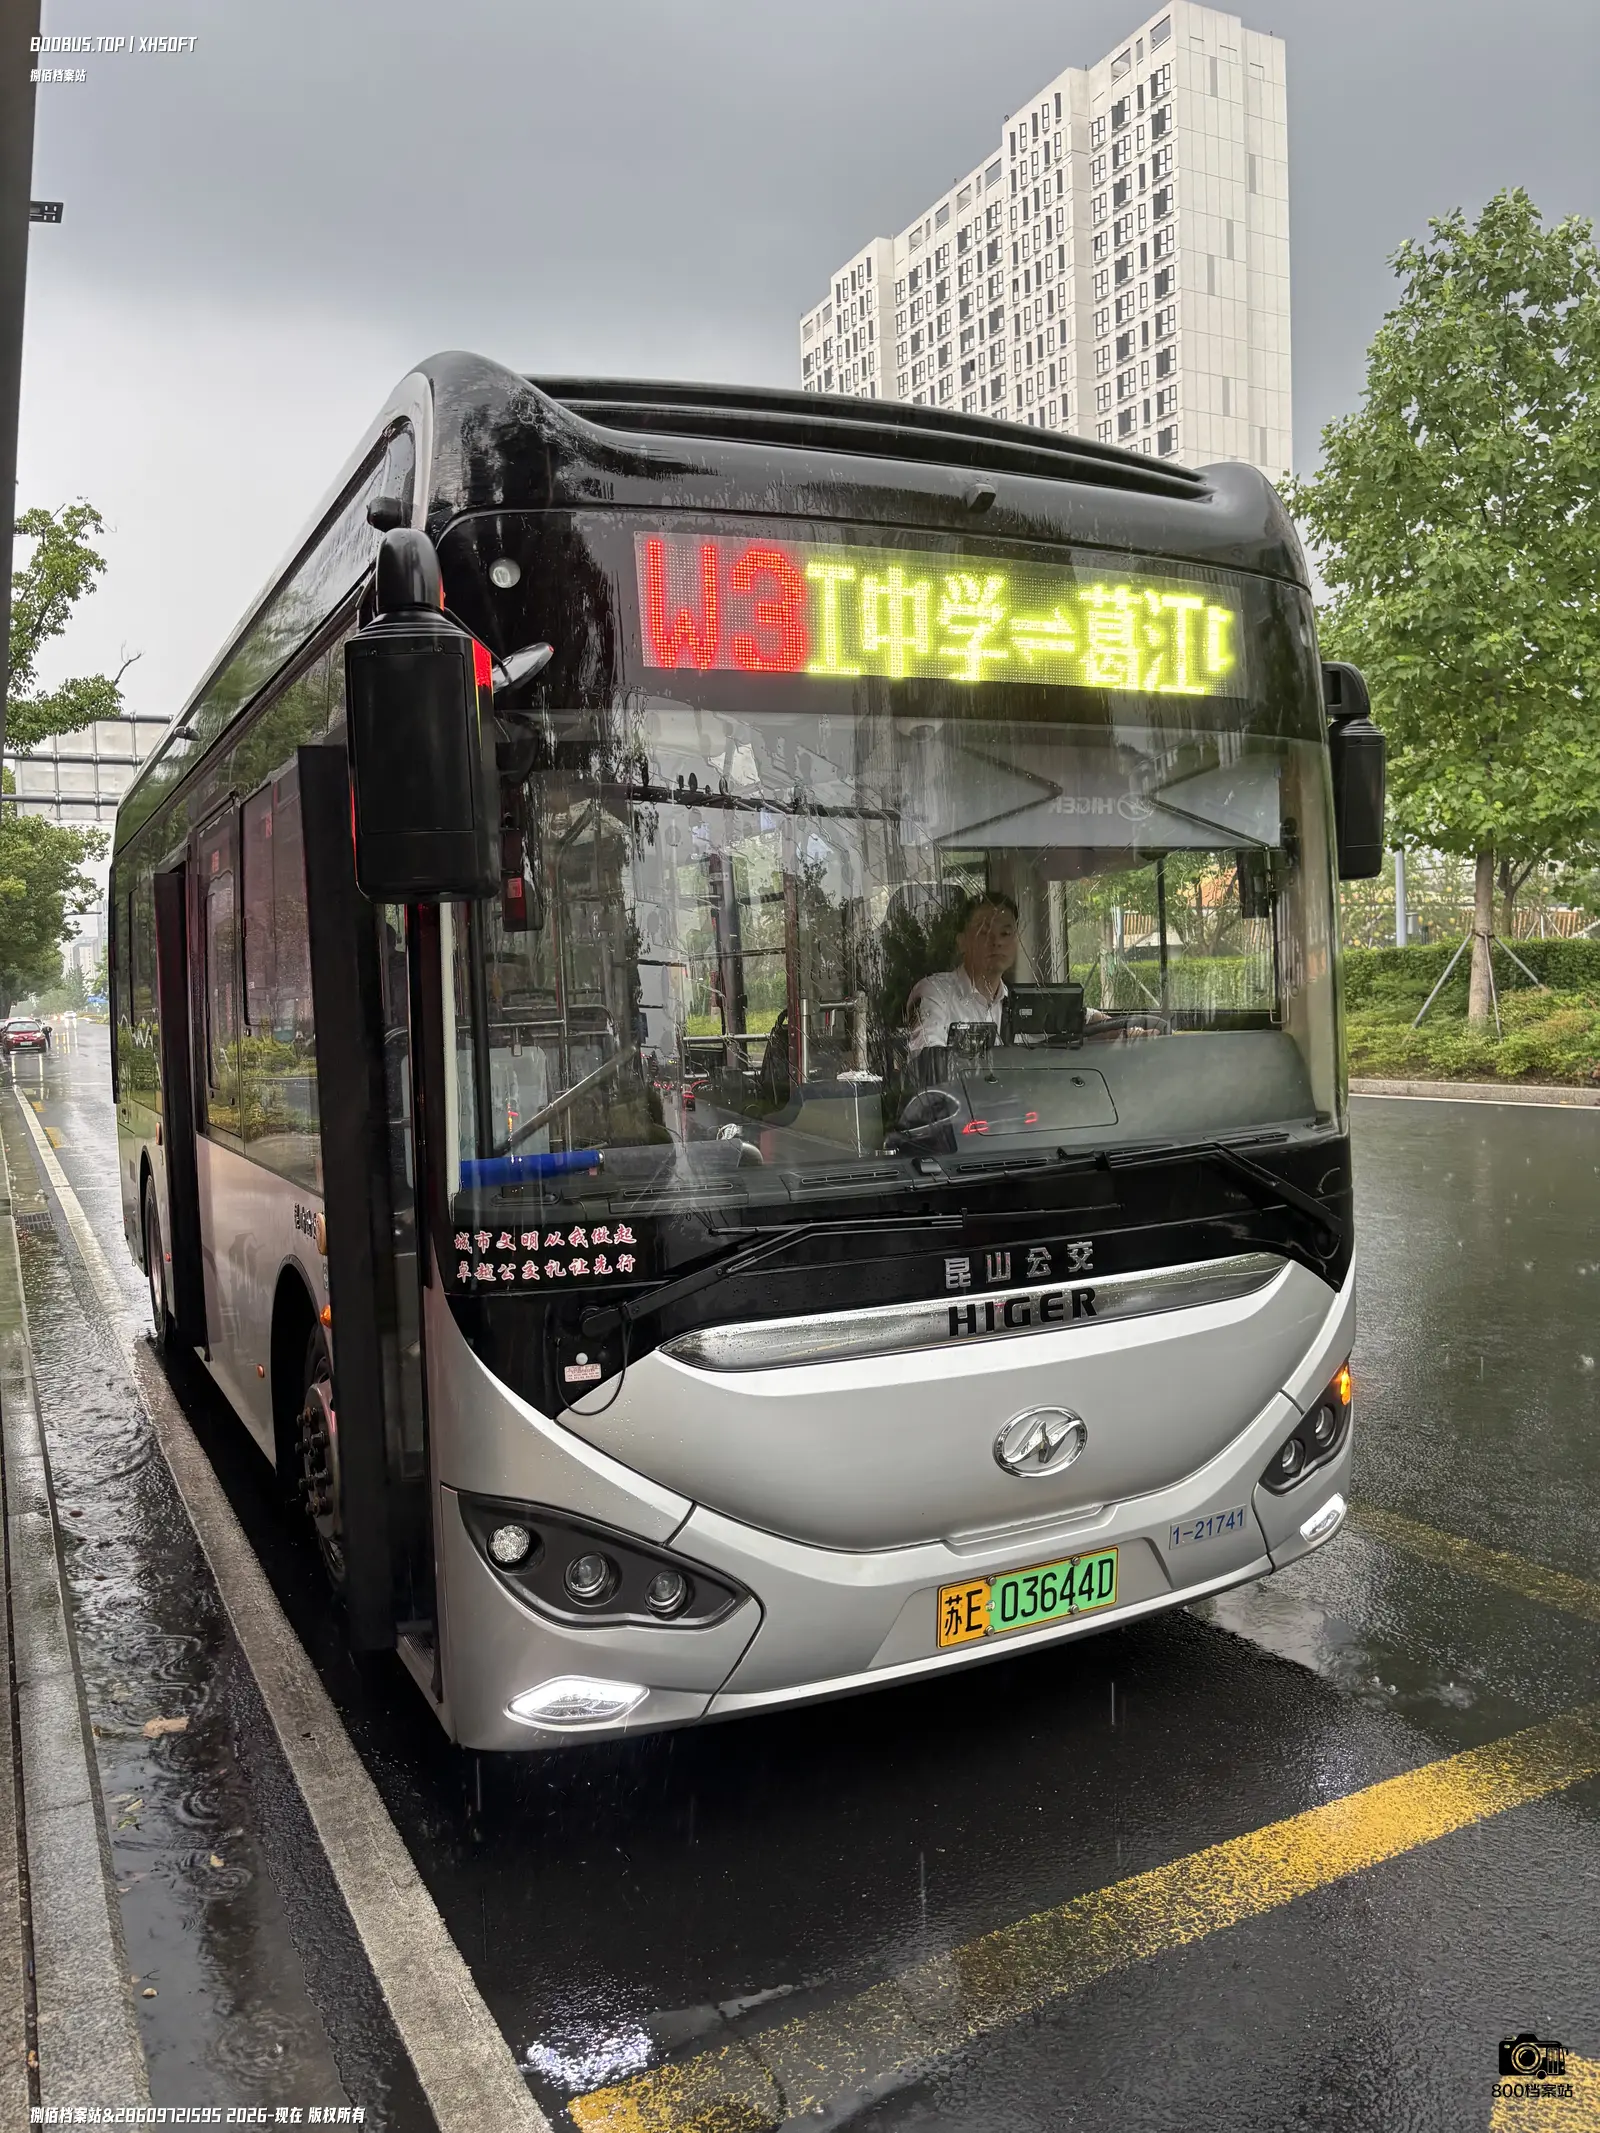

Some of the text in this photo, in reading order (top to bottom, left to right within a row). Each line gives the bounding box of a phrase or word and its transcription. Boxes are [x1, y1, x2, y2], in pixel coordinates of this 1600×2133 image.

[647, 539, 807, 672] W3
[454, 1223, 637, 1254] 城市文明从我做起
[456, 1253, 636, 1283] 卓越公交礼让先行
[944, 1240, 1095, 1290] 昆山公交
[948, 1287, 1098, 1337] HIGER
[1171, 1508, 1246, 1546] 1-21741
[1001, 1557, 1115, 1622] 03644D
